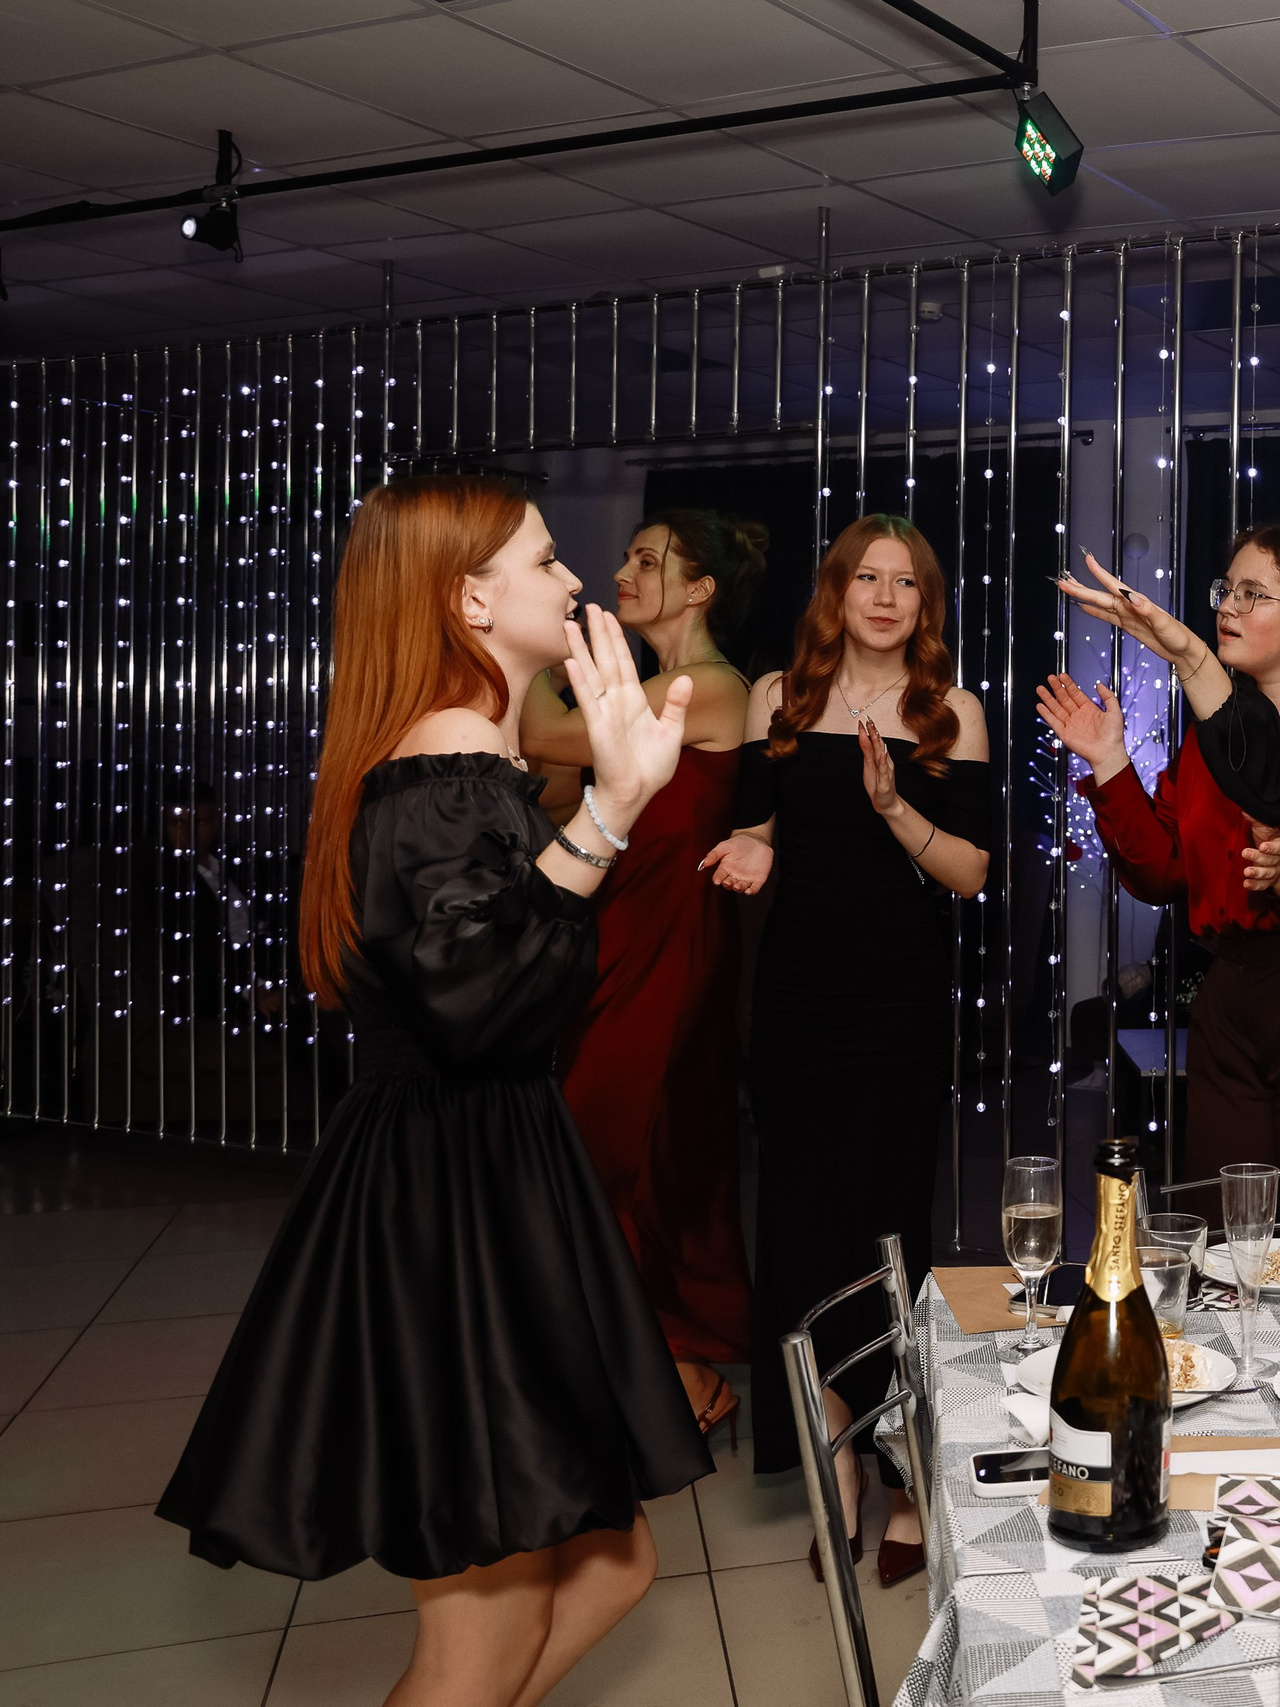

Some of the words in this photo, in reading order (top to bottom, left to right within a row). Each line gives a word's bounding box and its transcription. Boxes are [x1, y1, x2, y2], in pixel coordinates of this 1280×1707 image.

[1114, 1182, 1129, 1232] STEFANO
[1110, 1235, 1122, 1272] SANTO
[1053, 1458, 1090, 1480] EFANO
